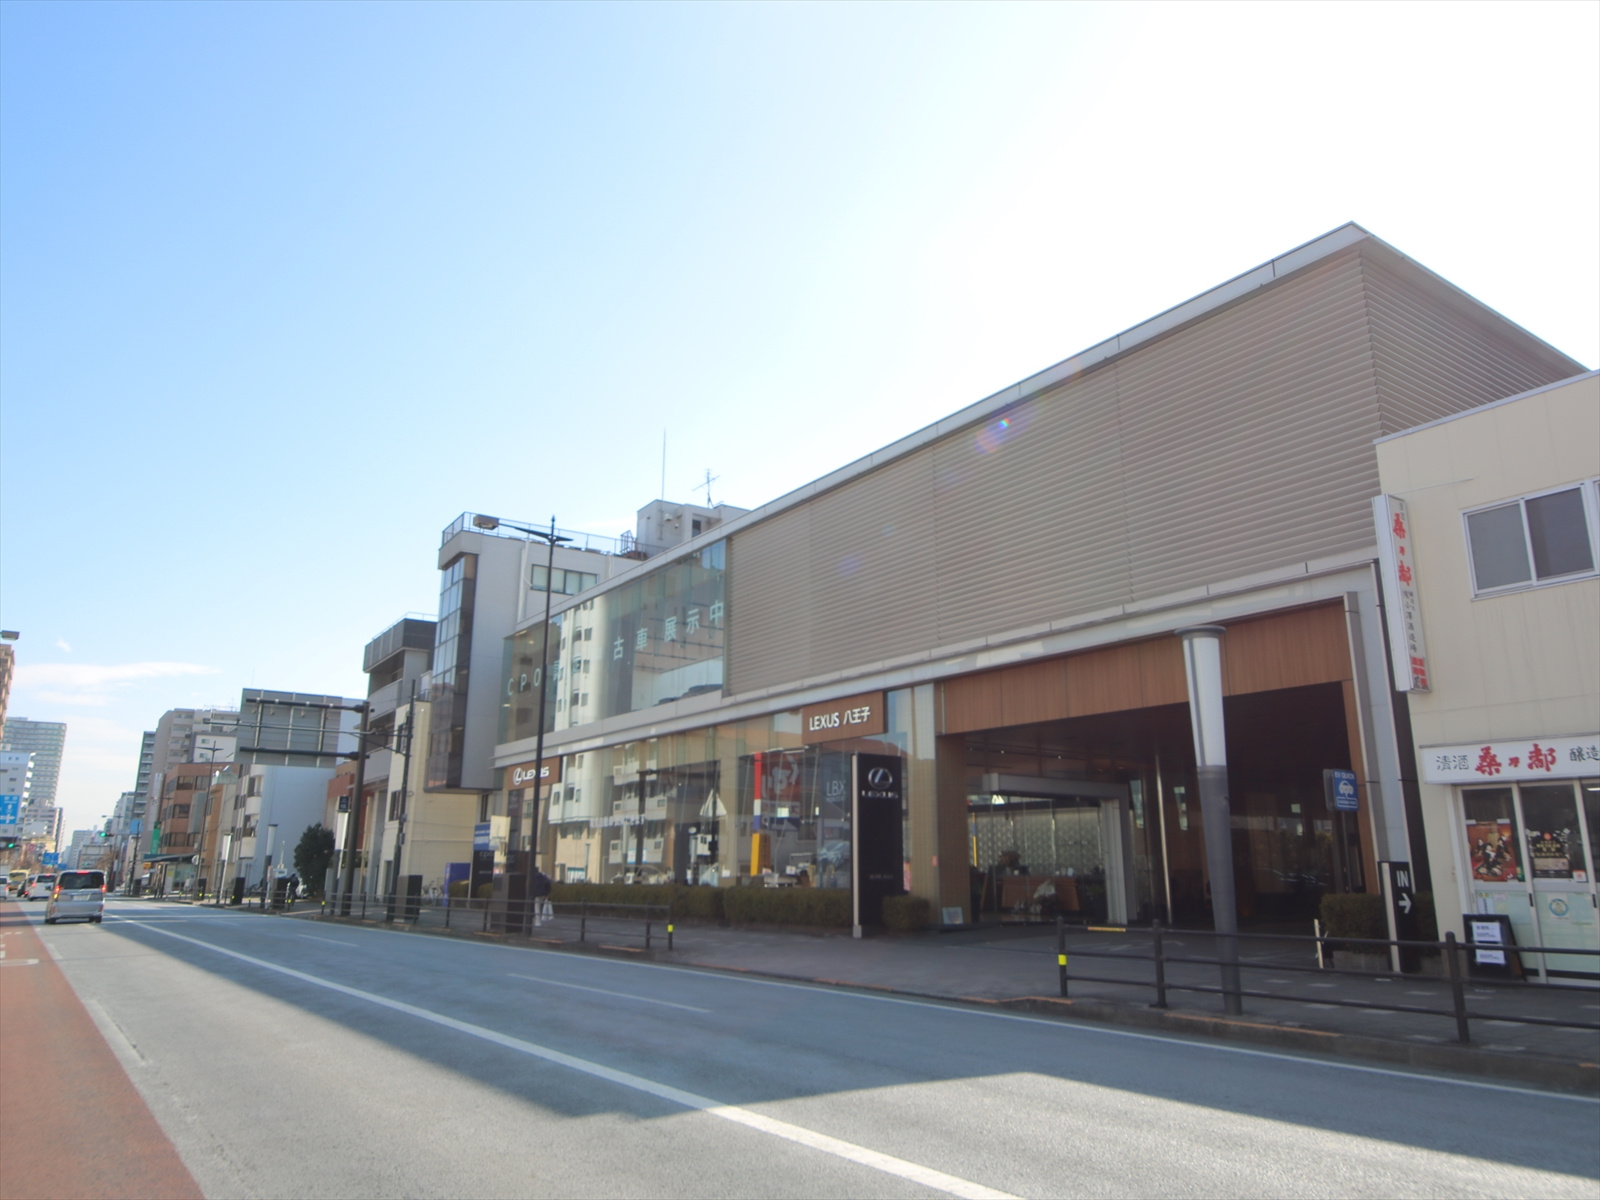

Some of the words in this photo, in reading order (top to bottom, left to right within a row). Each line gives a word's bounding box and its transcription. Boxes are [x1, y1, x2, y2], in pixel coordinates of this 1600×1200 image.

[809, 712, 840, 731] LEXUS
[843, 706, 871, 725] 八王子
[1436, 755, 1469, 771] 清酒
[826, 780, 846, 796] LBX
[862, 790, 899, 799] LEXUS
[1396, 870, 1409, 888] IN
